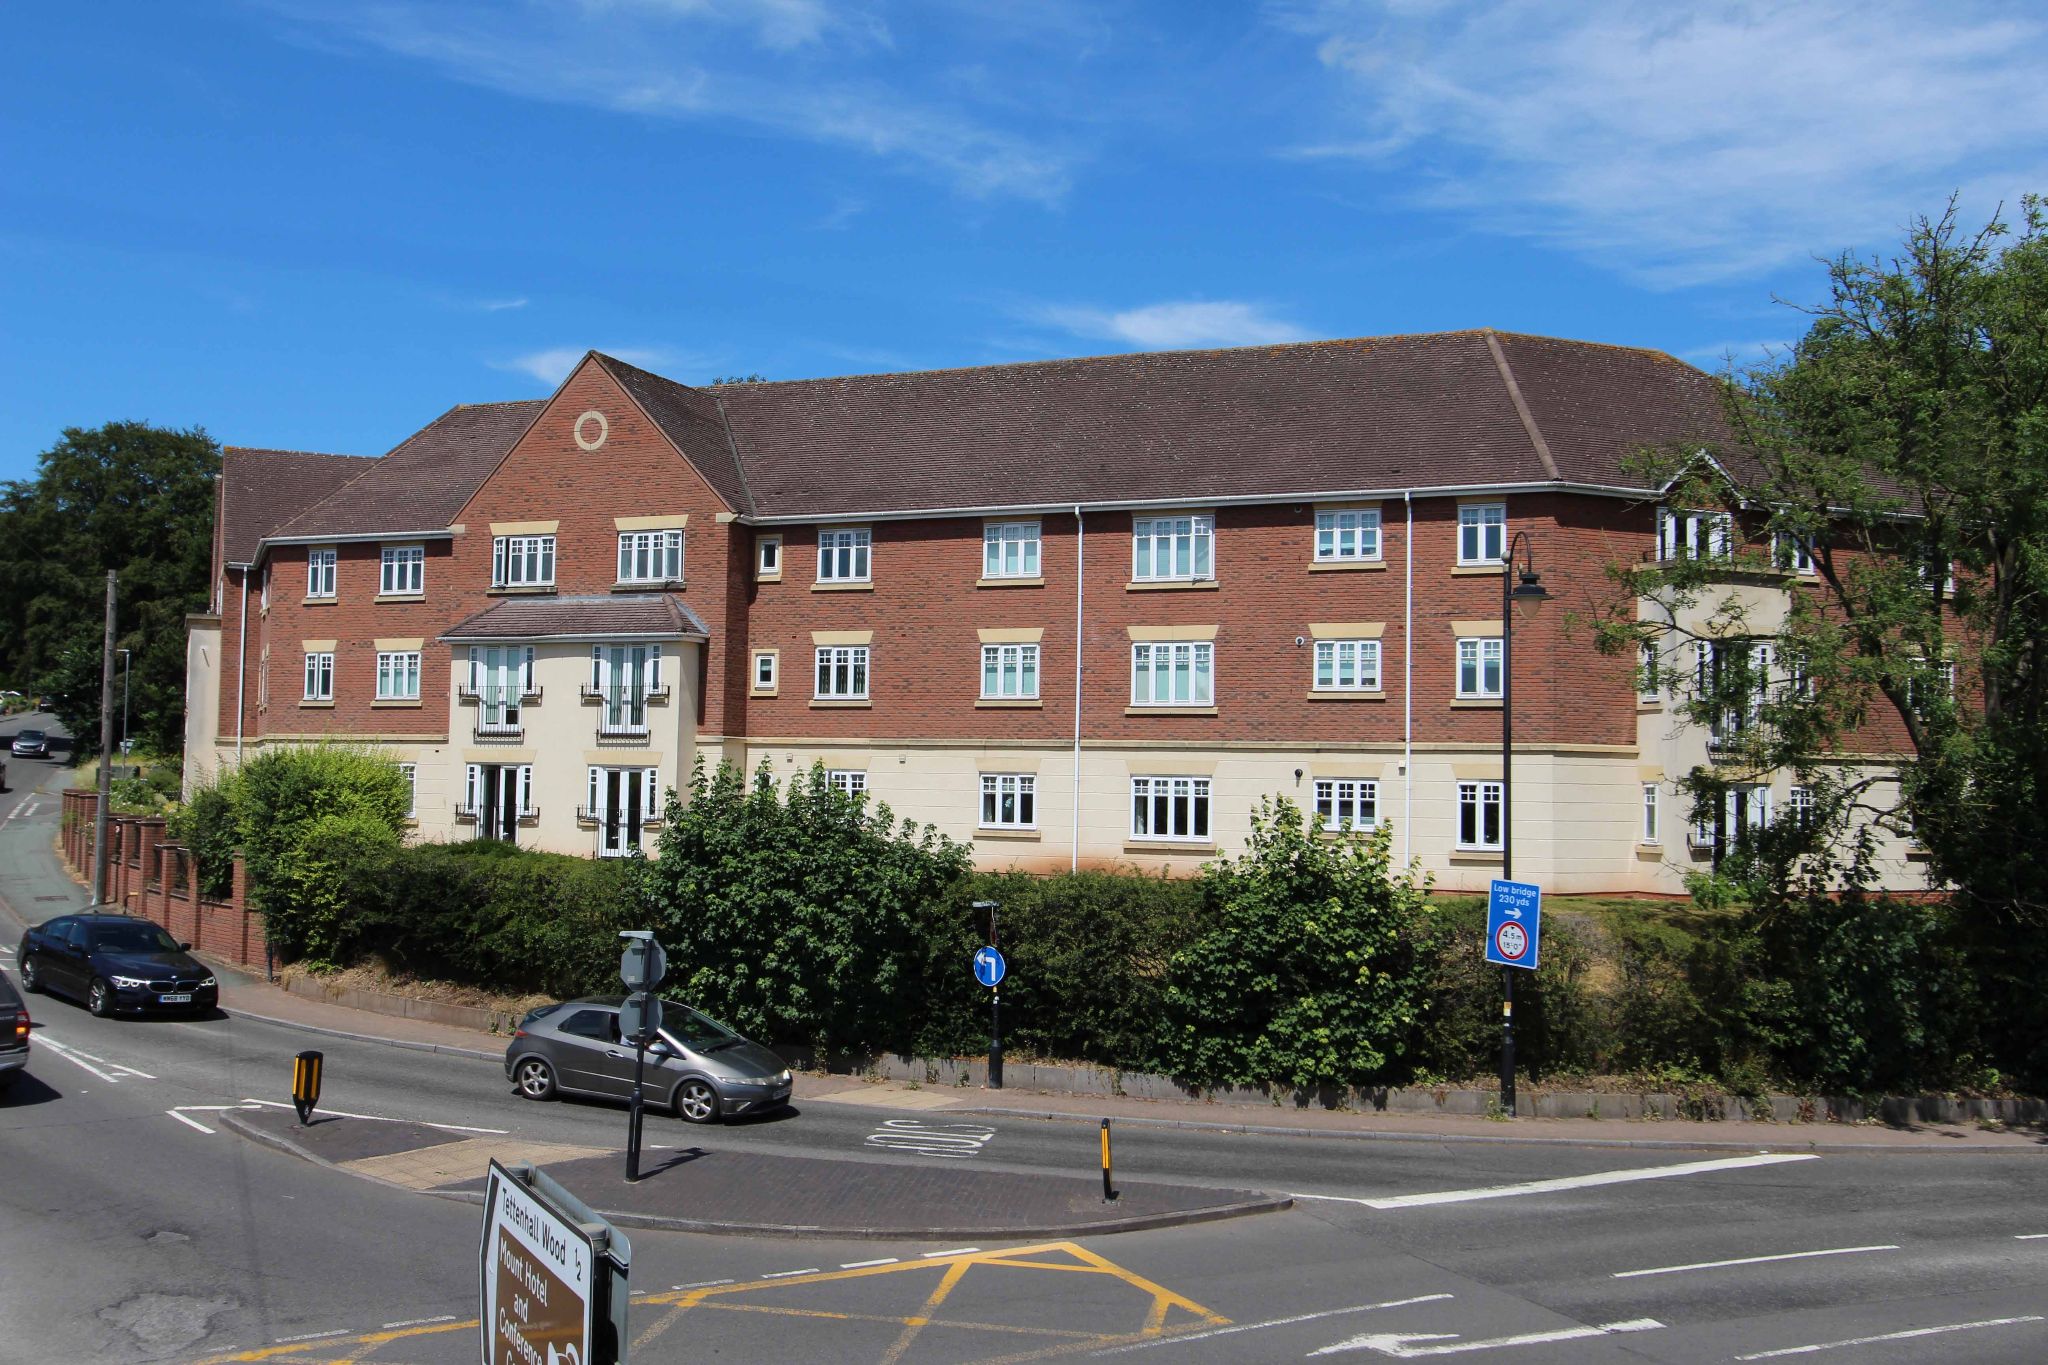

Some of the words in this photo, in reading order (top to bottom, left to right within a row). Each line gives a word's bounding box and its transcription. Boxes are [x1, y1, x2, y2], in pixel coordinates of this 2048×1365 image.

[1494, 883, 1509, 893] Low
[1511, 885, 1536, 898] bridge
[1499, 894, 1515, 904] 230
[1516, 898, 1530, 907] yds
[502, 1187, 540, 1243] Tettenhall
[542, 1220, 566, 1266] Wood
[500, 1237, 523, 1282] Mount
[525, 1261, 548, 1307] Hotel
[513, 1293, 529, 1323] and
[499, 1307, 542, 1365] Conference
